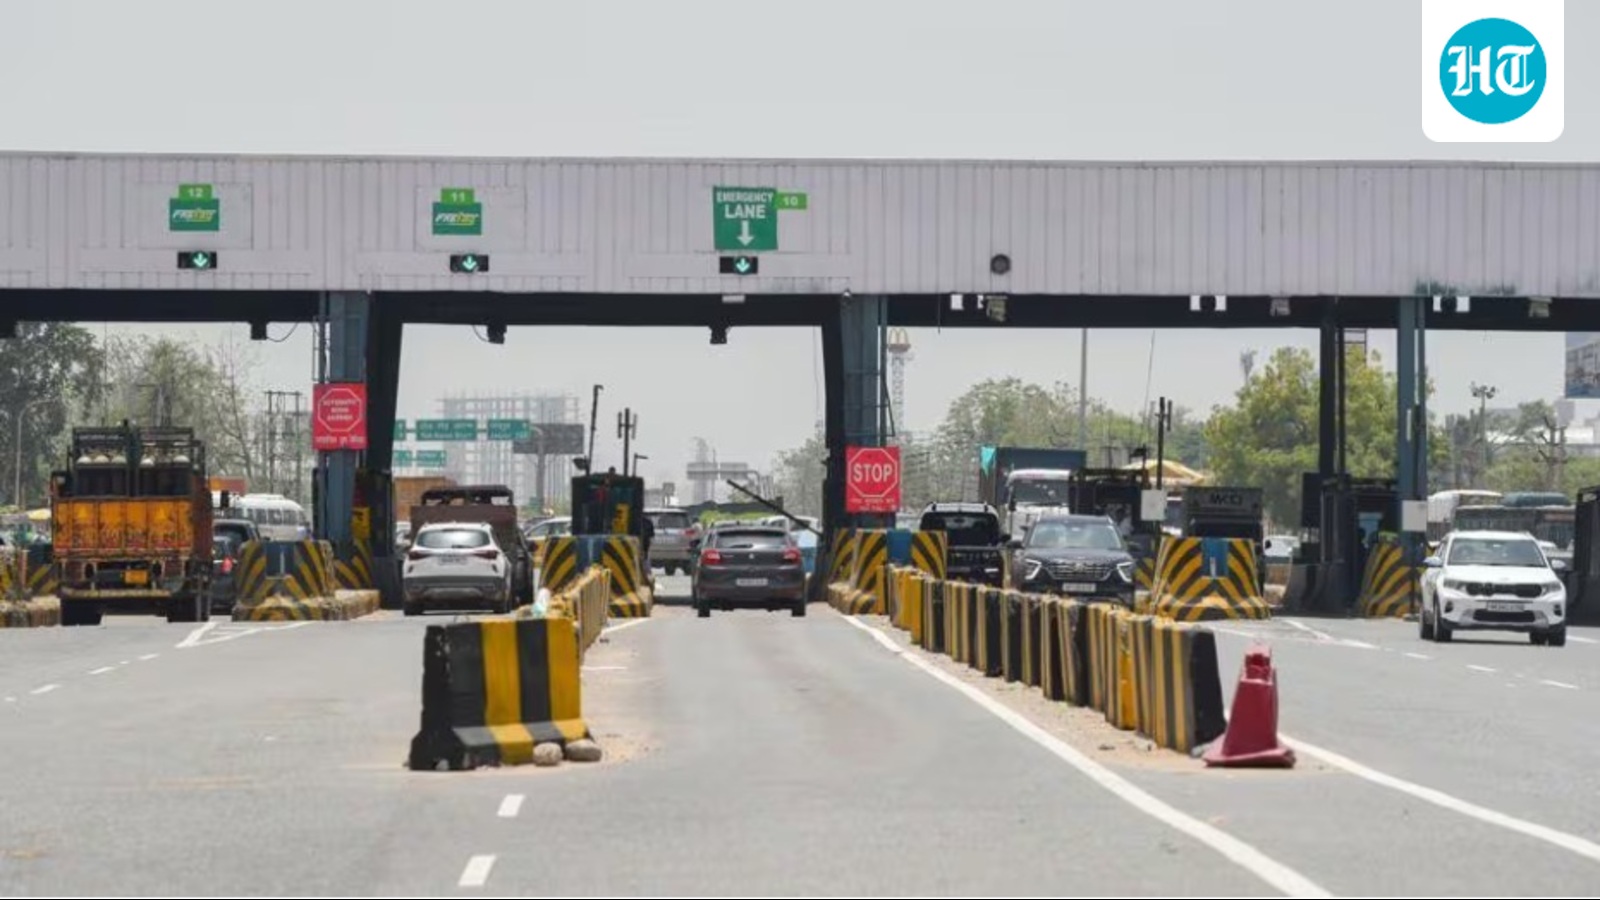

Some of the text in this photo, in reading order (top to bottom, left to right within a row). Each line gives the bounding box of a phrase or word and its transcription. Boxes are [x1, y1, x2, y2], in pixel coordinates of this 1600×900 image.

[188, 187, 203, 198] 12
[452, 191, 465, 202] 11
[716, 191, 774, 203] EMERGENCY
[783, 196, 799, 206] 10
[724, 204, 766, 219] LANE
[853, 463, 893, 482] STOP
